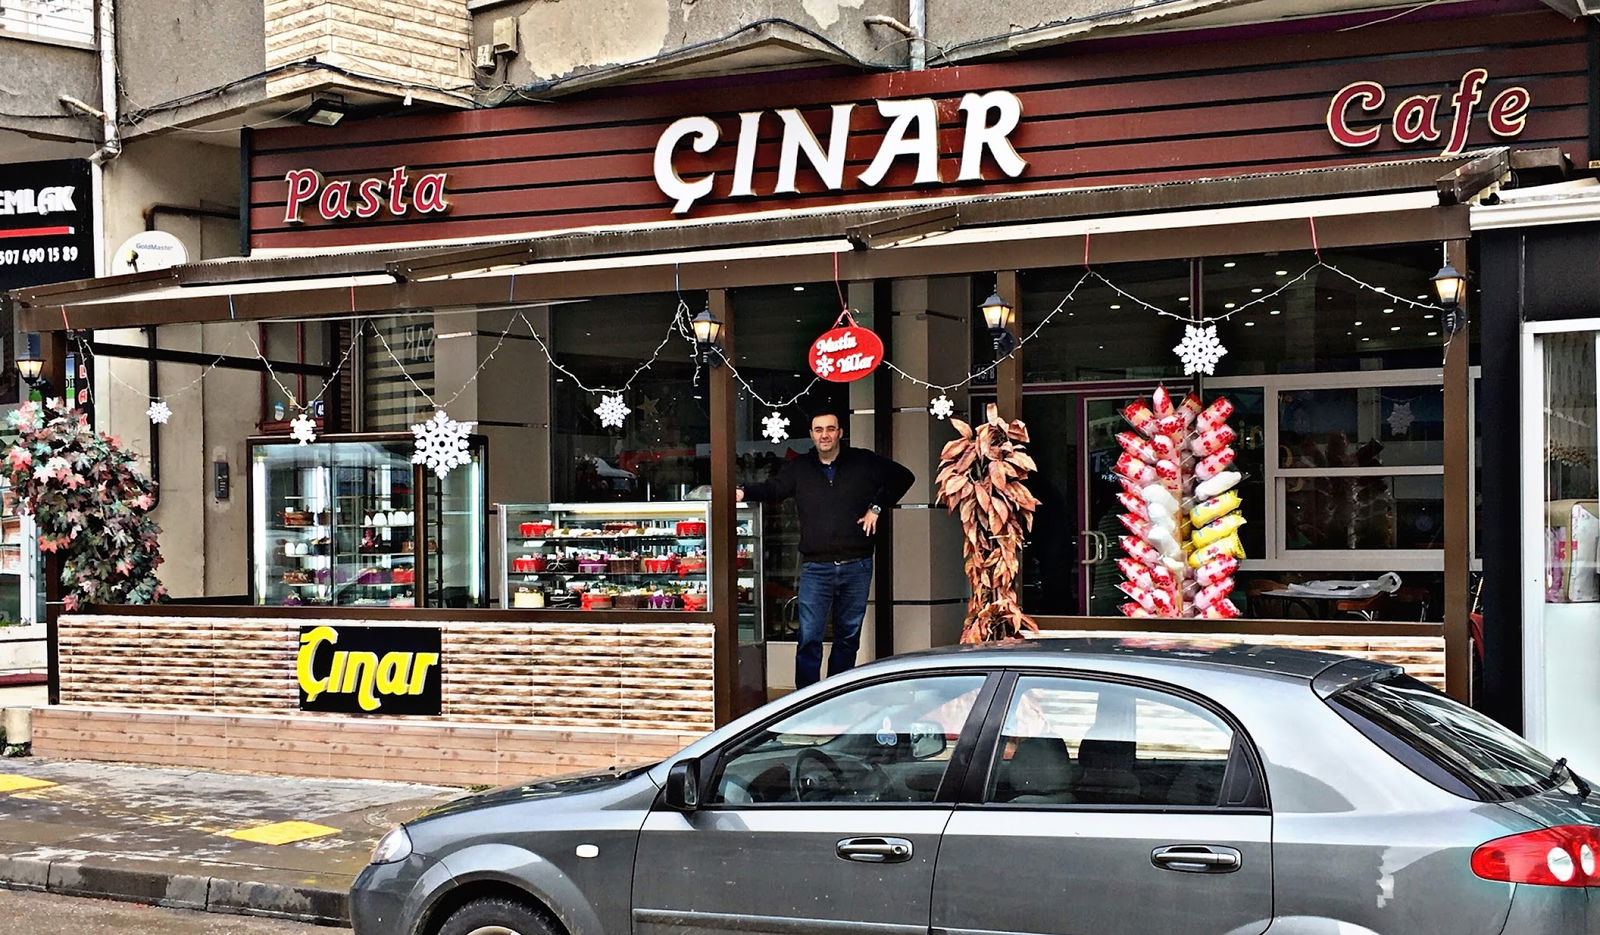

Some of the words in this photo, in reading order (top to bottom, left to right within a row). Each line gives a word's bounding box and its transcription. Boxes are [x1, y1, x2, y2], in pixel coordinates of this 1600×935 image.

[653, 90, 1031, 214] ÇINAR
[1327, 68, 1531, 157] Cafe
[283, 166, 447, 223] Pasta
[22, 247, 45, 264] 490
[47, 246, 60, 262] 15
[62, 245, 78, 262] 89
[297, 625, 439, 711] Çınar
